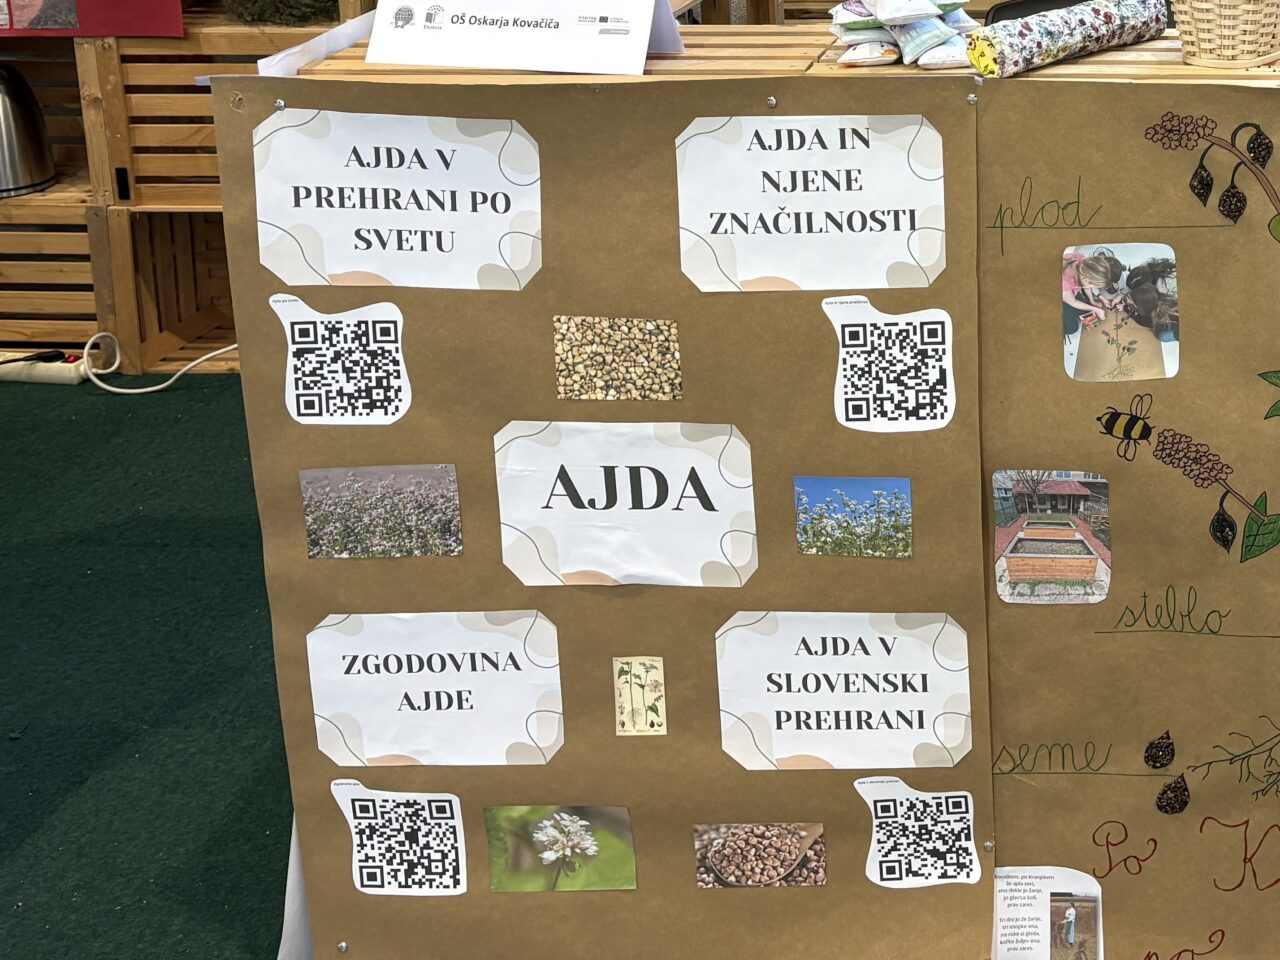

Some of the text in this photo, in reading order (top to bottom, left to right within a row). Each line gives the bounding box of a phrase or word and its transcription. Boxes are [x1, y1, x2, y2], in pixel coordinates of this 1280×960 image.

[450, 12, 560, 29] OŠ Oskarja Kovačiča
[745, 126, 871, 152] AJDA IN
[343, 146, 458, 171] AJDA V
[760, 168, 863, 194] NJENE
[291, 185, 513, 215] PREHRANI PO
[708, 205, 918, 236] ZNAČILNOSTI
[991, 174, 1103, 256] plod
[353, 226, 456, 254] SVETU
[541, 463, 720, 513] AJDA
[1114, 584, 1232, 636] steblo
[794, 636, 898, 658] AJDA V
[341, 651, 523, 676] ZGODOVINA
[765, 671, 930, 694] SLOVENSKI
[396, 689, 475, 713] AJDE
[774, 707, 926, 732] PREHRANI
[992, 739, 1114, 774] seme
